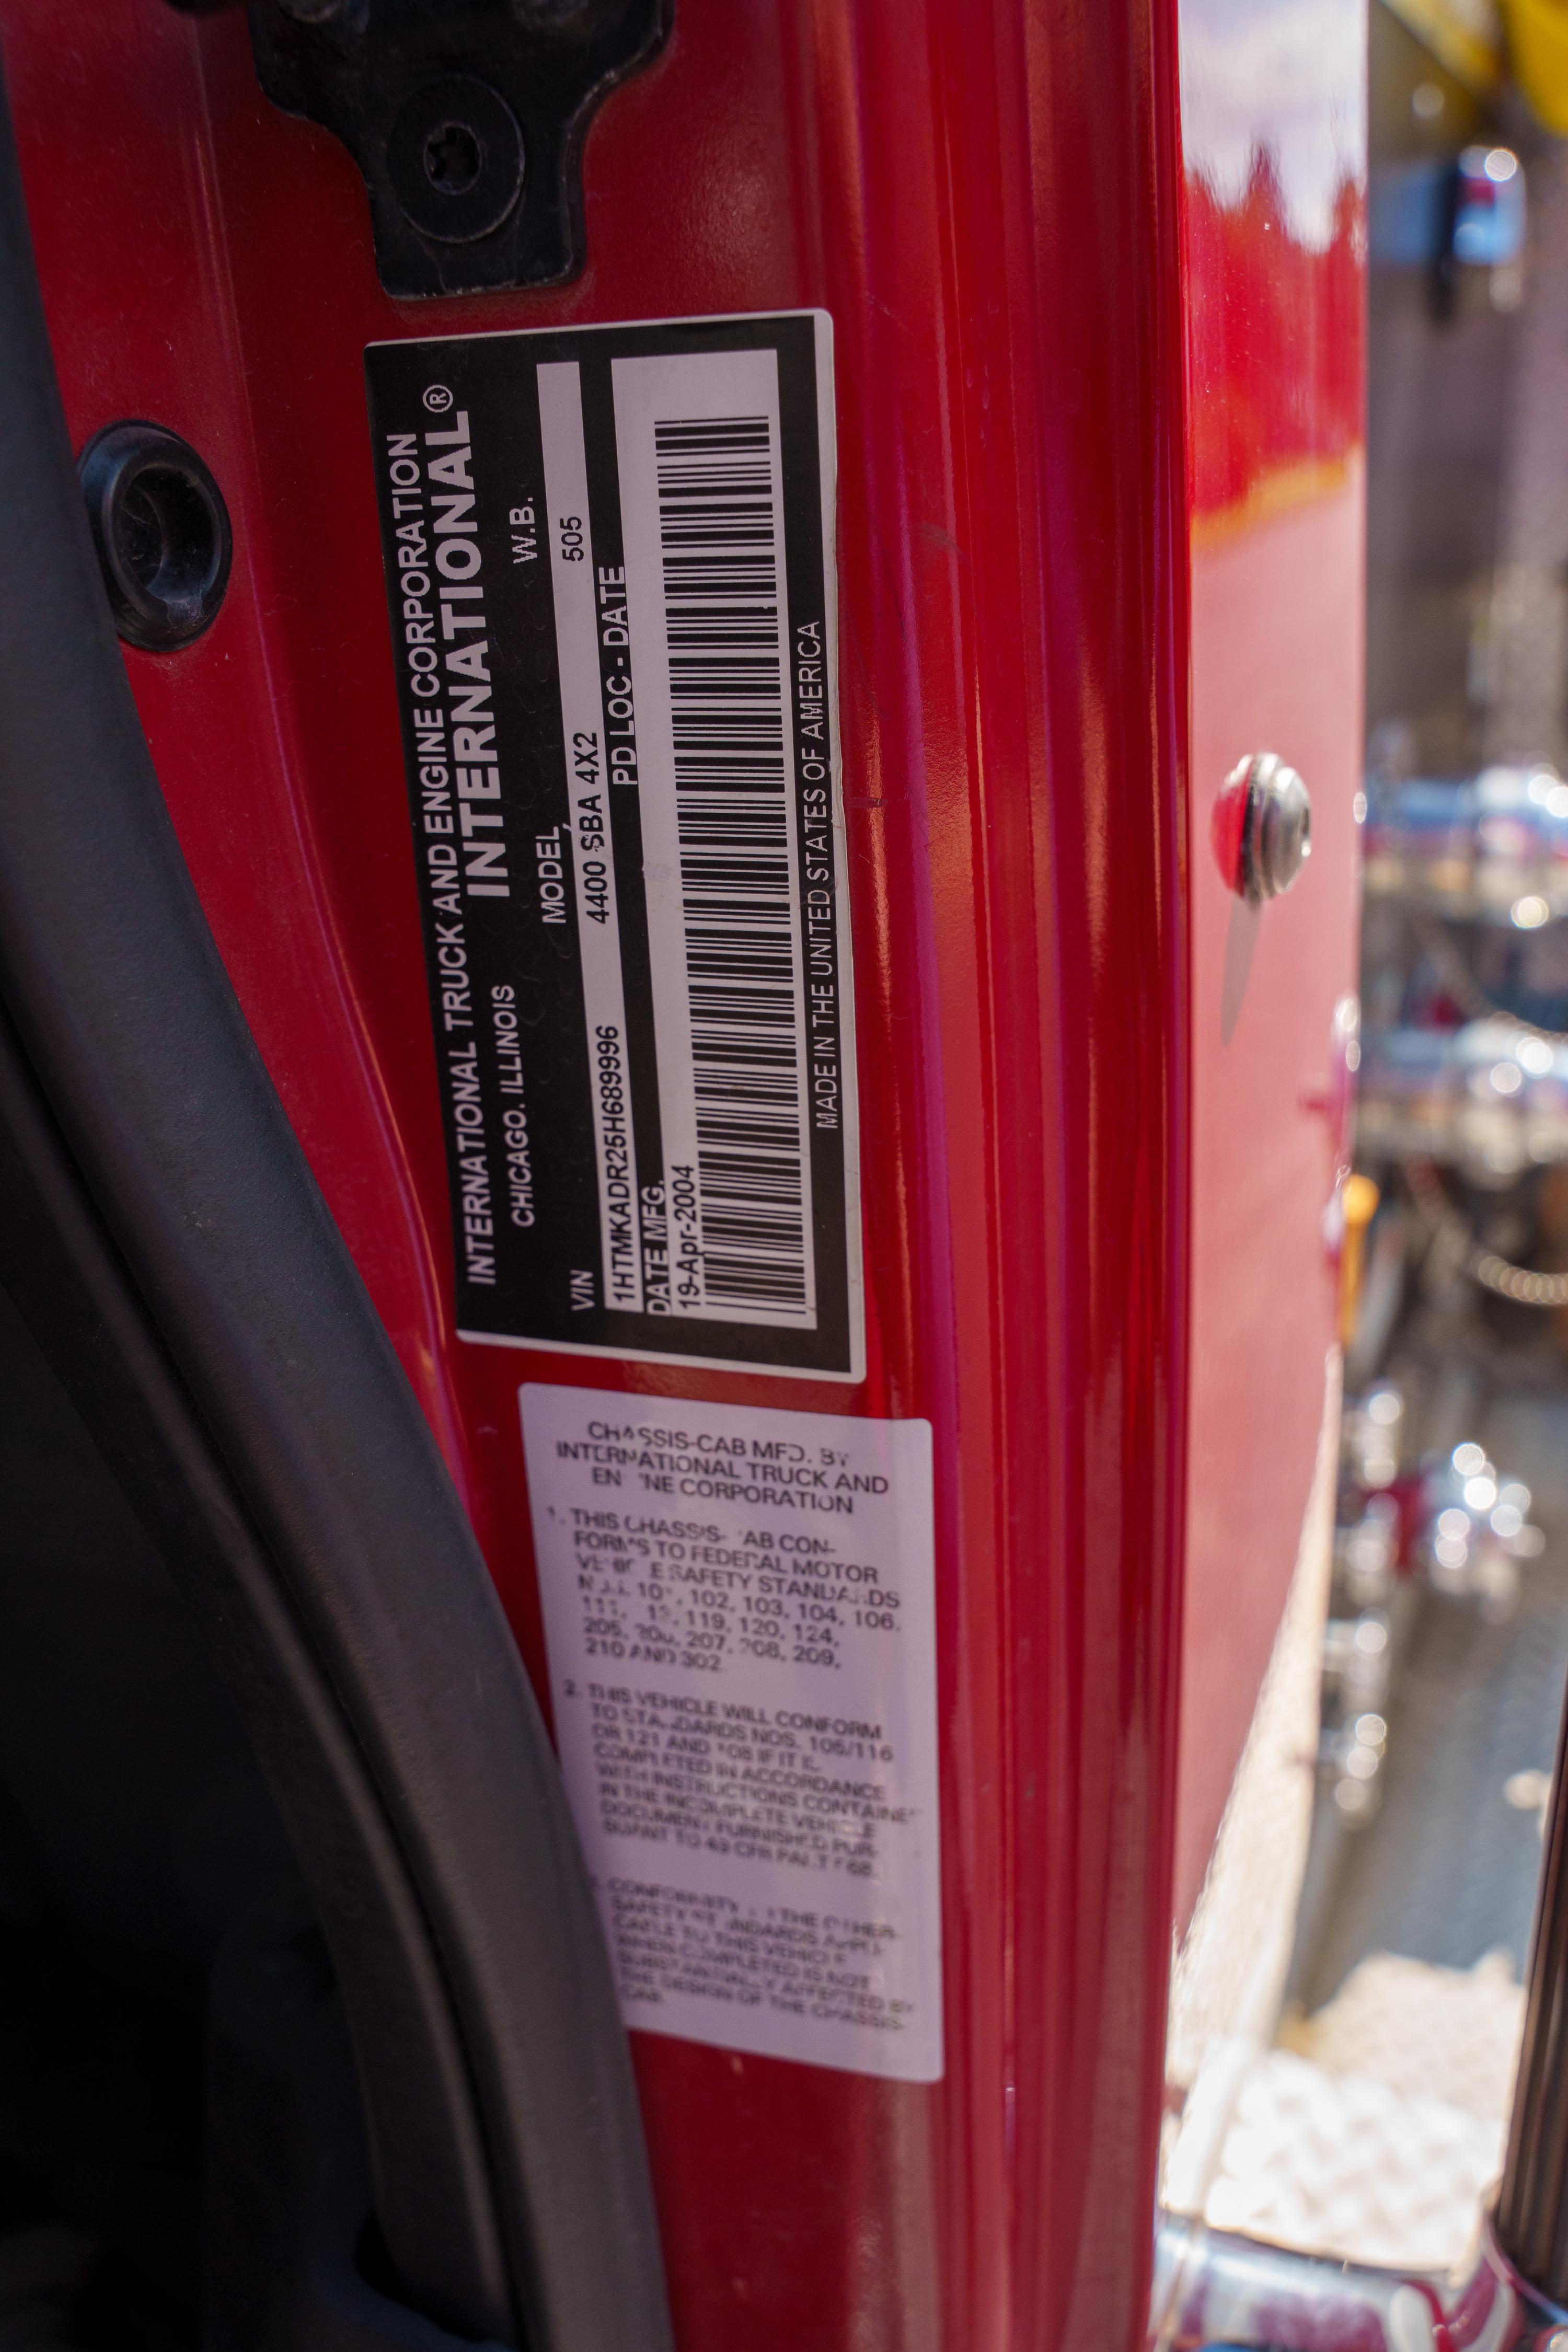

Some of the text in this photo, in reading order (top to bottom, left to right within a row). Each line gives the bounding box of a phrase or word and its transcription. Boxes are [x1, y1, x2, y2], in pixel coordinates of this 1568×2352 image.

[509, 497, 537, 563] W.B.
[559, 515, 584, 561] 505
[598, 566, 629, 645] DATE
[606, 675, 635, 735] LOC
[610, 746, 638, 784] PD
[387, 433, 496, 1284] INTERNATIONAL TRUCK AND ENGINE CORPORATION
[572, 732, 610, 924] 4400 SBA 4X2
[536, 826, 567, 924] MODEL
[797, 621, 838, 1128] MADE IN THE UNITED STATES OF AMERICA
[491, 985, 524, 1094] ILLINOIS
[596, 1025, 636, 1302] 1HTMKADR25H689996
[641, 1179, 672, 1314] DATE MFG.
[671, 1165, 705, 1309] 19-Apr-2004
[570, 1269, 595, 1310] VIN
[556, 1440, 889, 1494] INTERNATIONAL TRUCK AND
[592, 1466, 852, 1514] ENNE CORPORATION
[571, 1507, 620, 1531] THIS
[655, 1540, 686, 1561] TO
[792, 1558, 879, 1584] MOTOR
